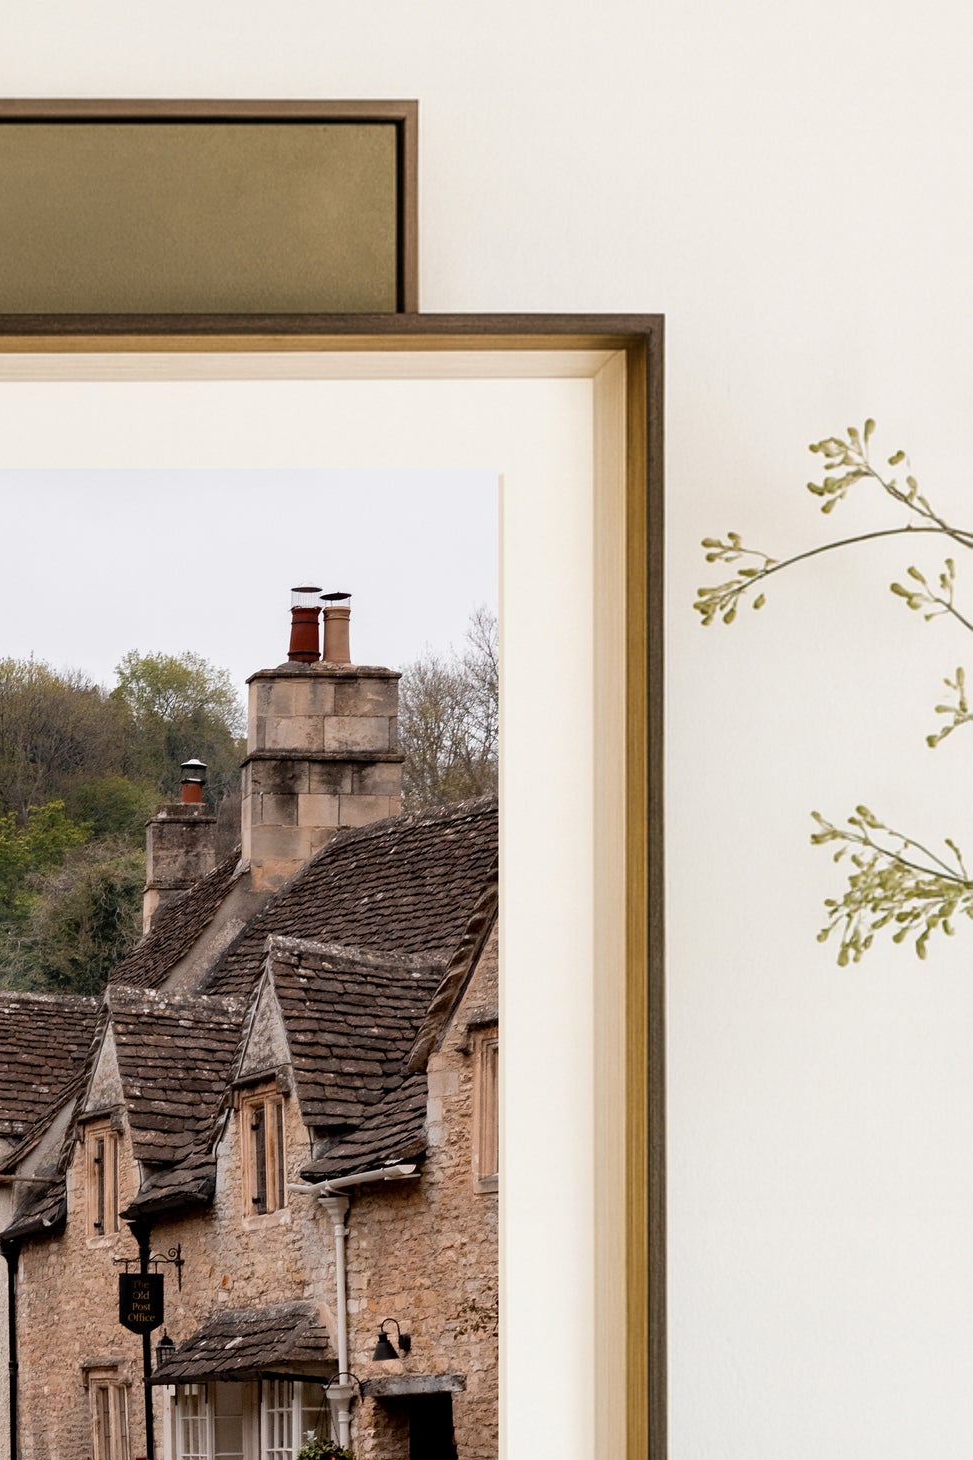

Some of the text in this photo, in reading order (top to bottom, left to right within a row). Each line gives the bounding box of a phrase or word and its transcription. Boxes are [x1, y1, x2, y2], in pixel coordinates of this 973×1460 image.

[132, 1280, 150, 1289] The
[132, 1290, 150, 1300] Old
[132, 1302, 151, 1311] Post
[127, 1312, 156, 1322] Office
